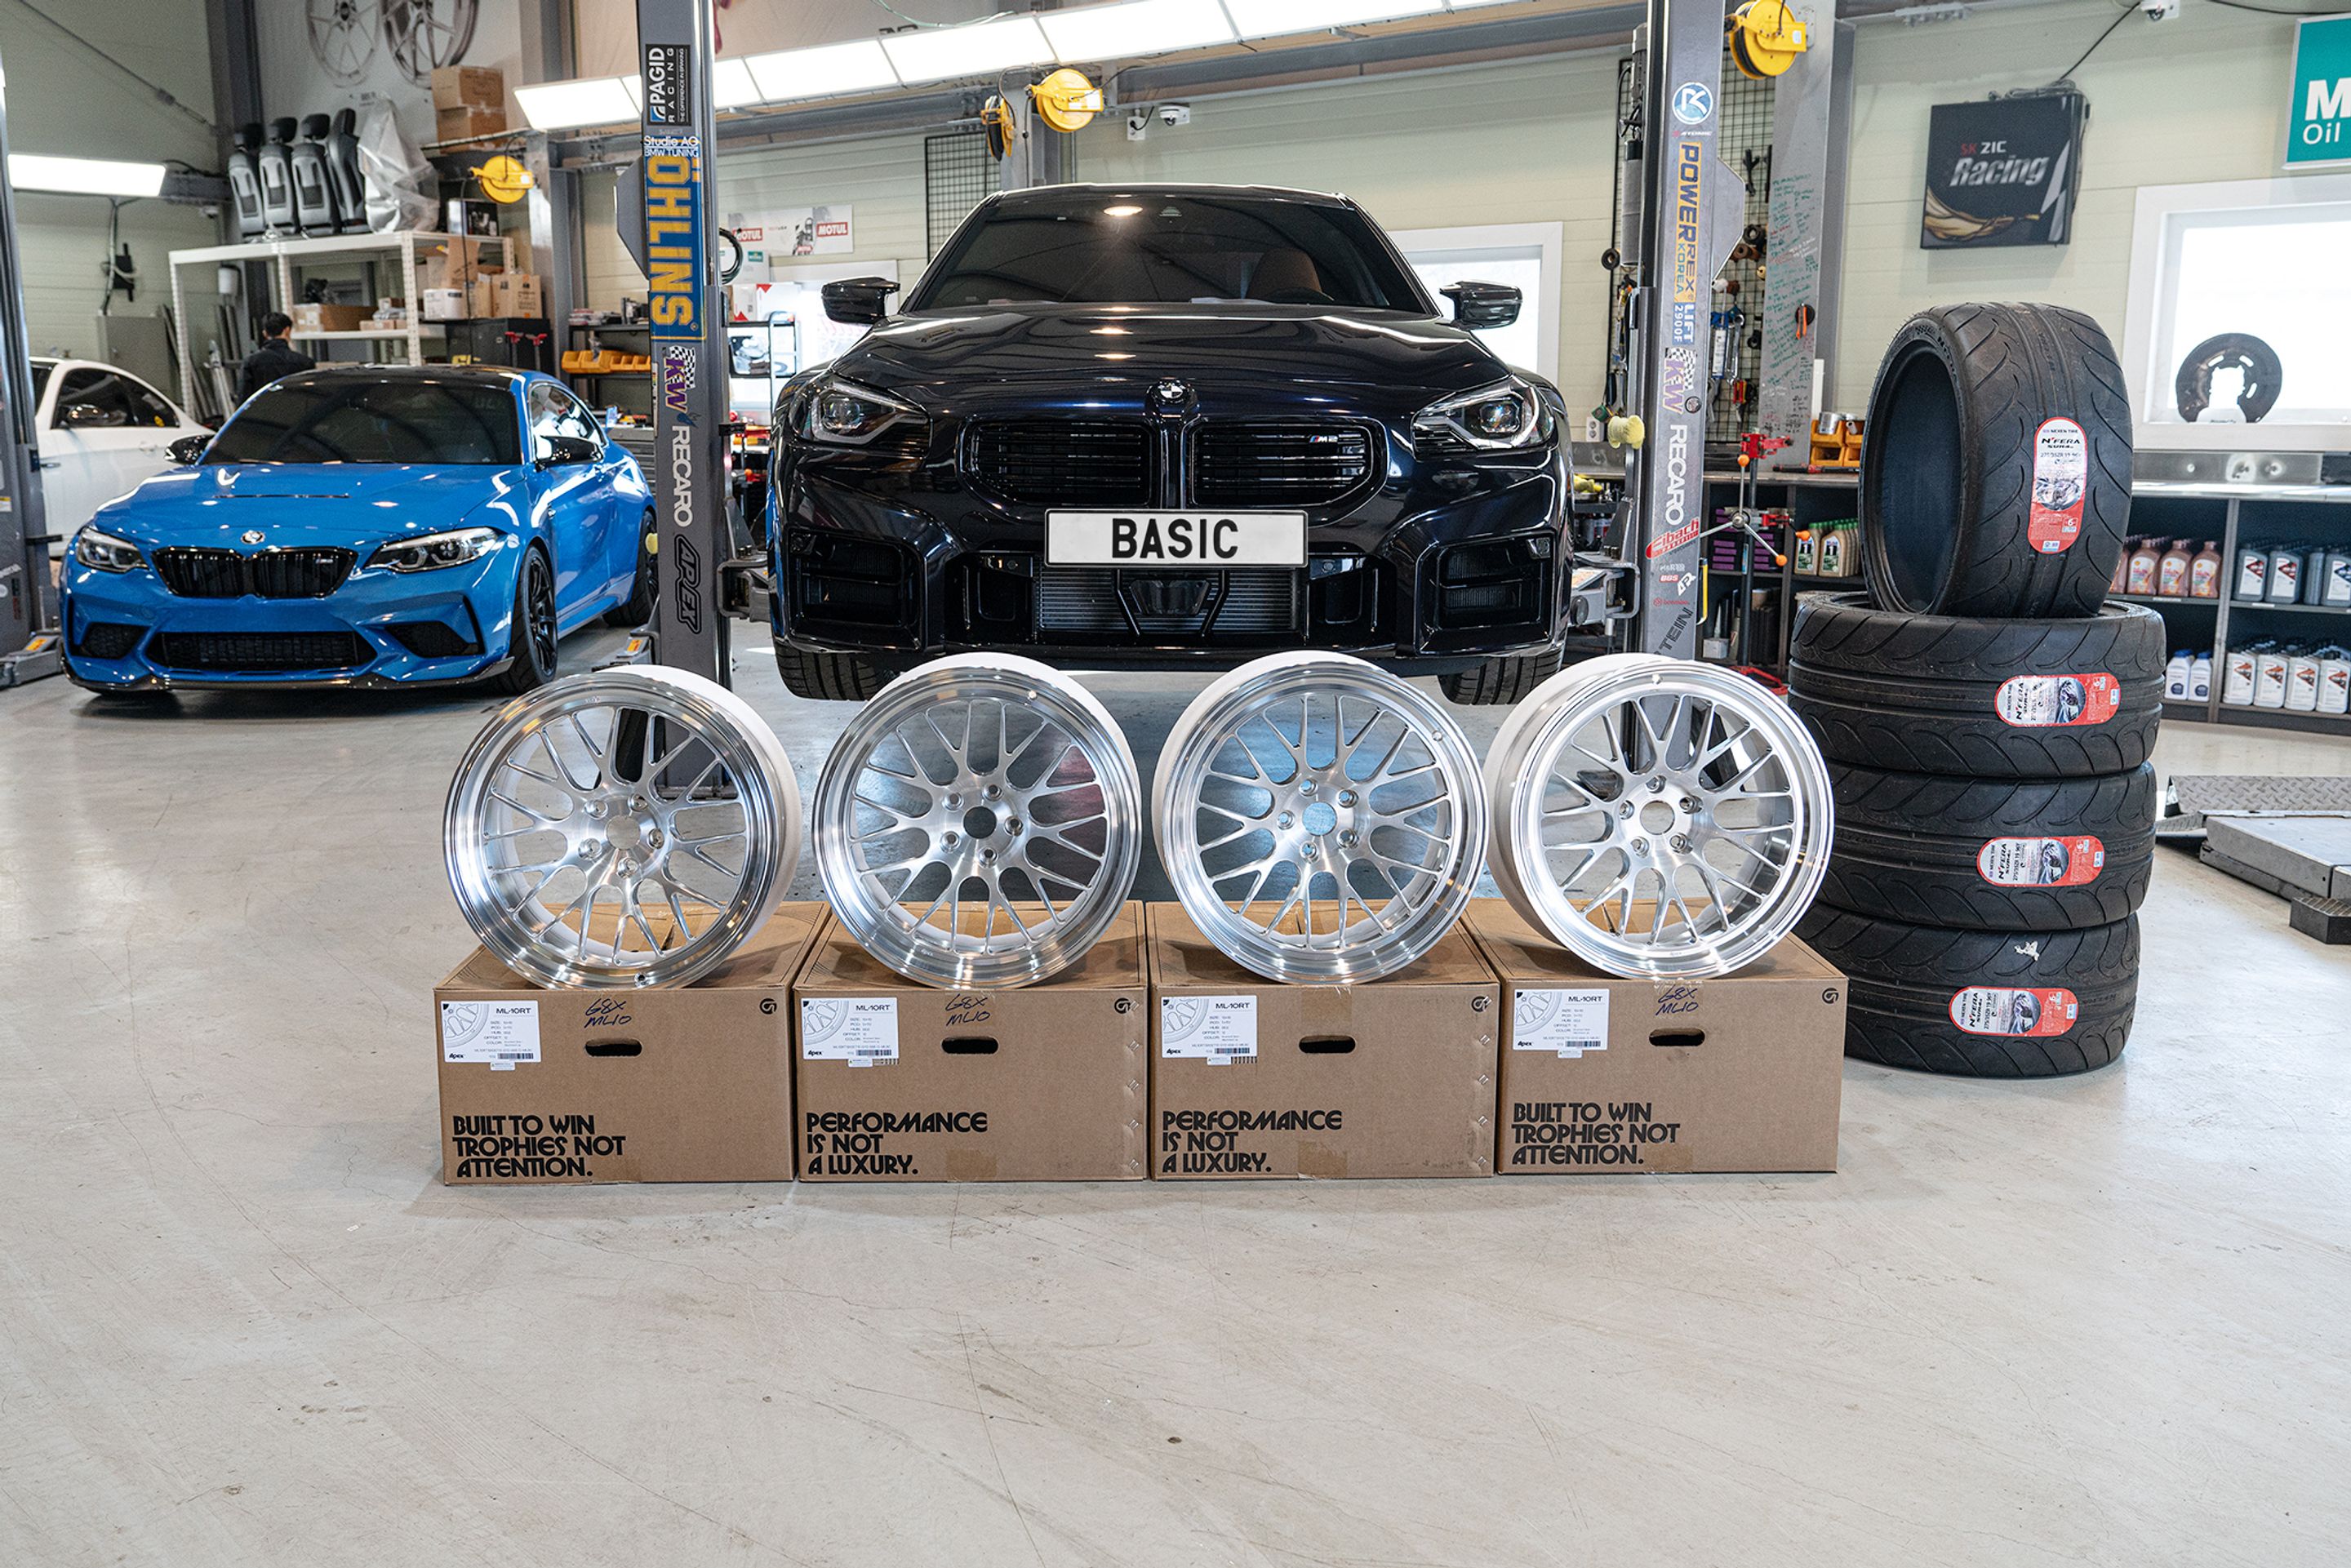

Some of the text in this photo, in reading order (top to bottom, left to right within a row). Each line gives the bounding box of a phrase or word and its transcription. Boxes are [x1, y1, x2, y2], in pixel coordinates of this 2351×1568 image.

[649, 47, 665, 104] PAGID
[667, 48, 675, 122] RACING
[2303, 122, 2340, 144] Oil
[644, 148, 699, 157] BMW TUNING
[1961, 140, 2007, 155] SK ZIC
[1949, 154, 2050, 186] Racing
[818, 224, 847, 235] MOTUL
[1675, 244, 1686, 294] KOREA
[1673, 304, 1683, 343] 2900F
[1683, 304, 1695, 343] LIFT
[663, 357, 689, 413] KW
[1662, 358, 1683, 415] KW
[672, 425, 692, 528] RECARO
[1665, 424, 1688, 526] RECARO
[1112, 518, 1239, 559] BASIC
[1646, 517, 1700, 559] Eibach
[1659, 607, 1694, 650] TEIN
[807, 1112, 988, 1133] PERFORMANCE
[1162, 1110, 1342, 1131] PERFORMANCE
[1513, 1102, 1652, 1123] BUILT TO WIN
[453, 1115, 594, 1135] BUILT TO WIN
[1512, 1123, 1680, 1144] TROPHIES NOT
[452, 1135, 626, 1157] TROPHIES NOT
[807, 1134, 883, 1154] IS NOT
[1162, 1131, 1239, 1152] IS NOT
[808, 1155, 918, 1175] A LUXURY.
[1162, 1153, 1272, 1172] A LUXURY.
[1512, 1144, 1644, 1165] ATTENTION.
[456, 1157, 593, 1178] ATTENTION.
